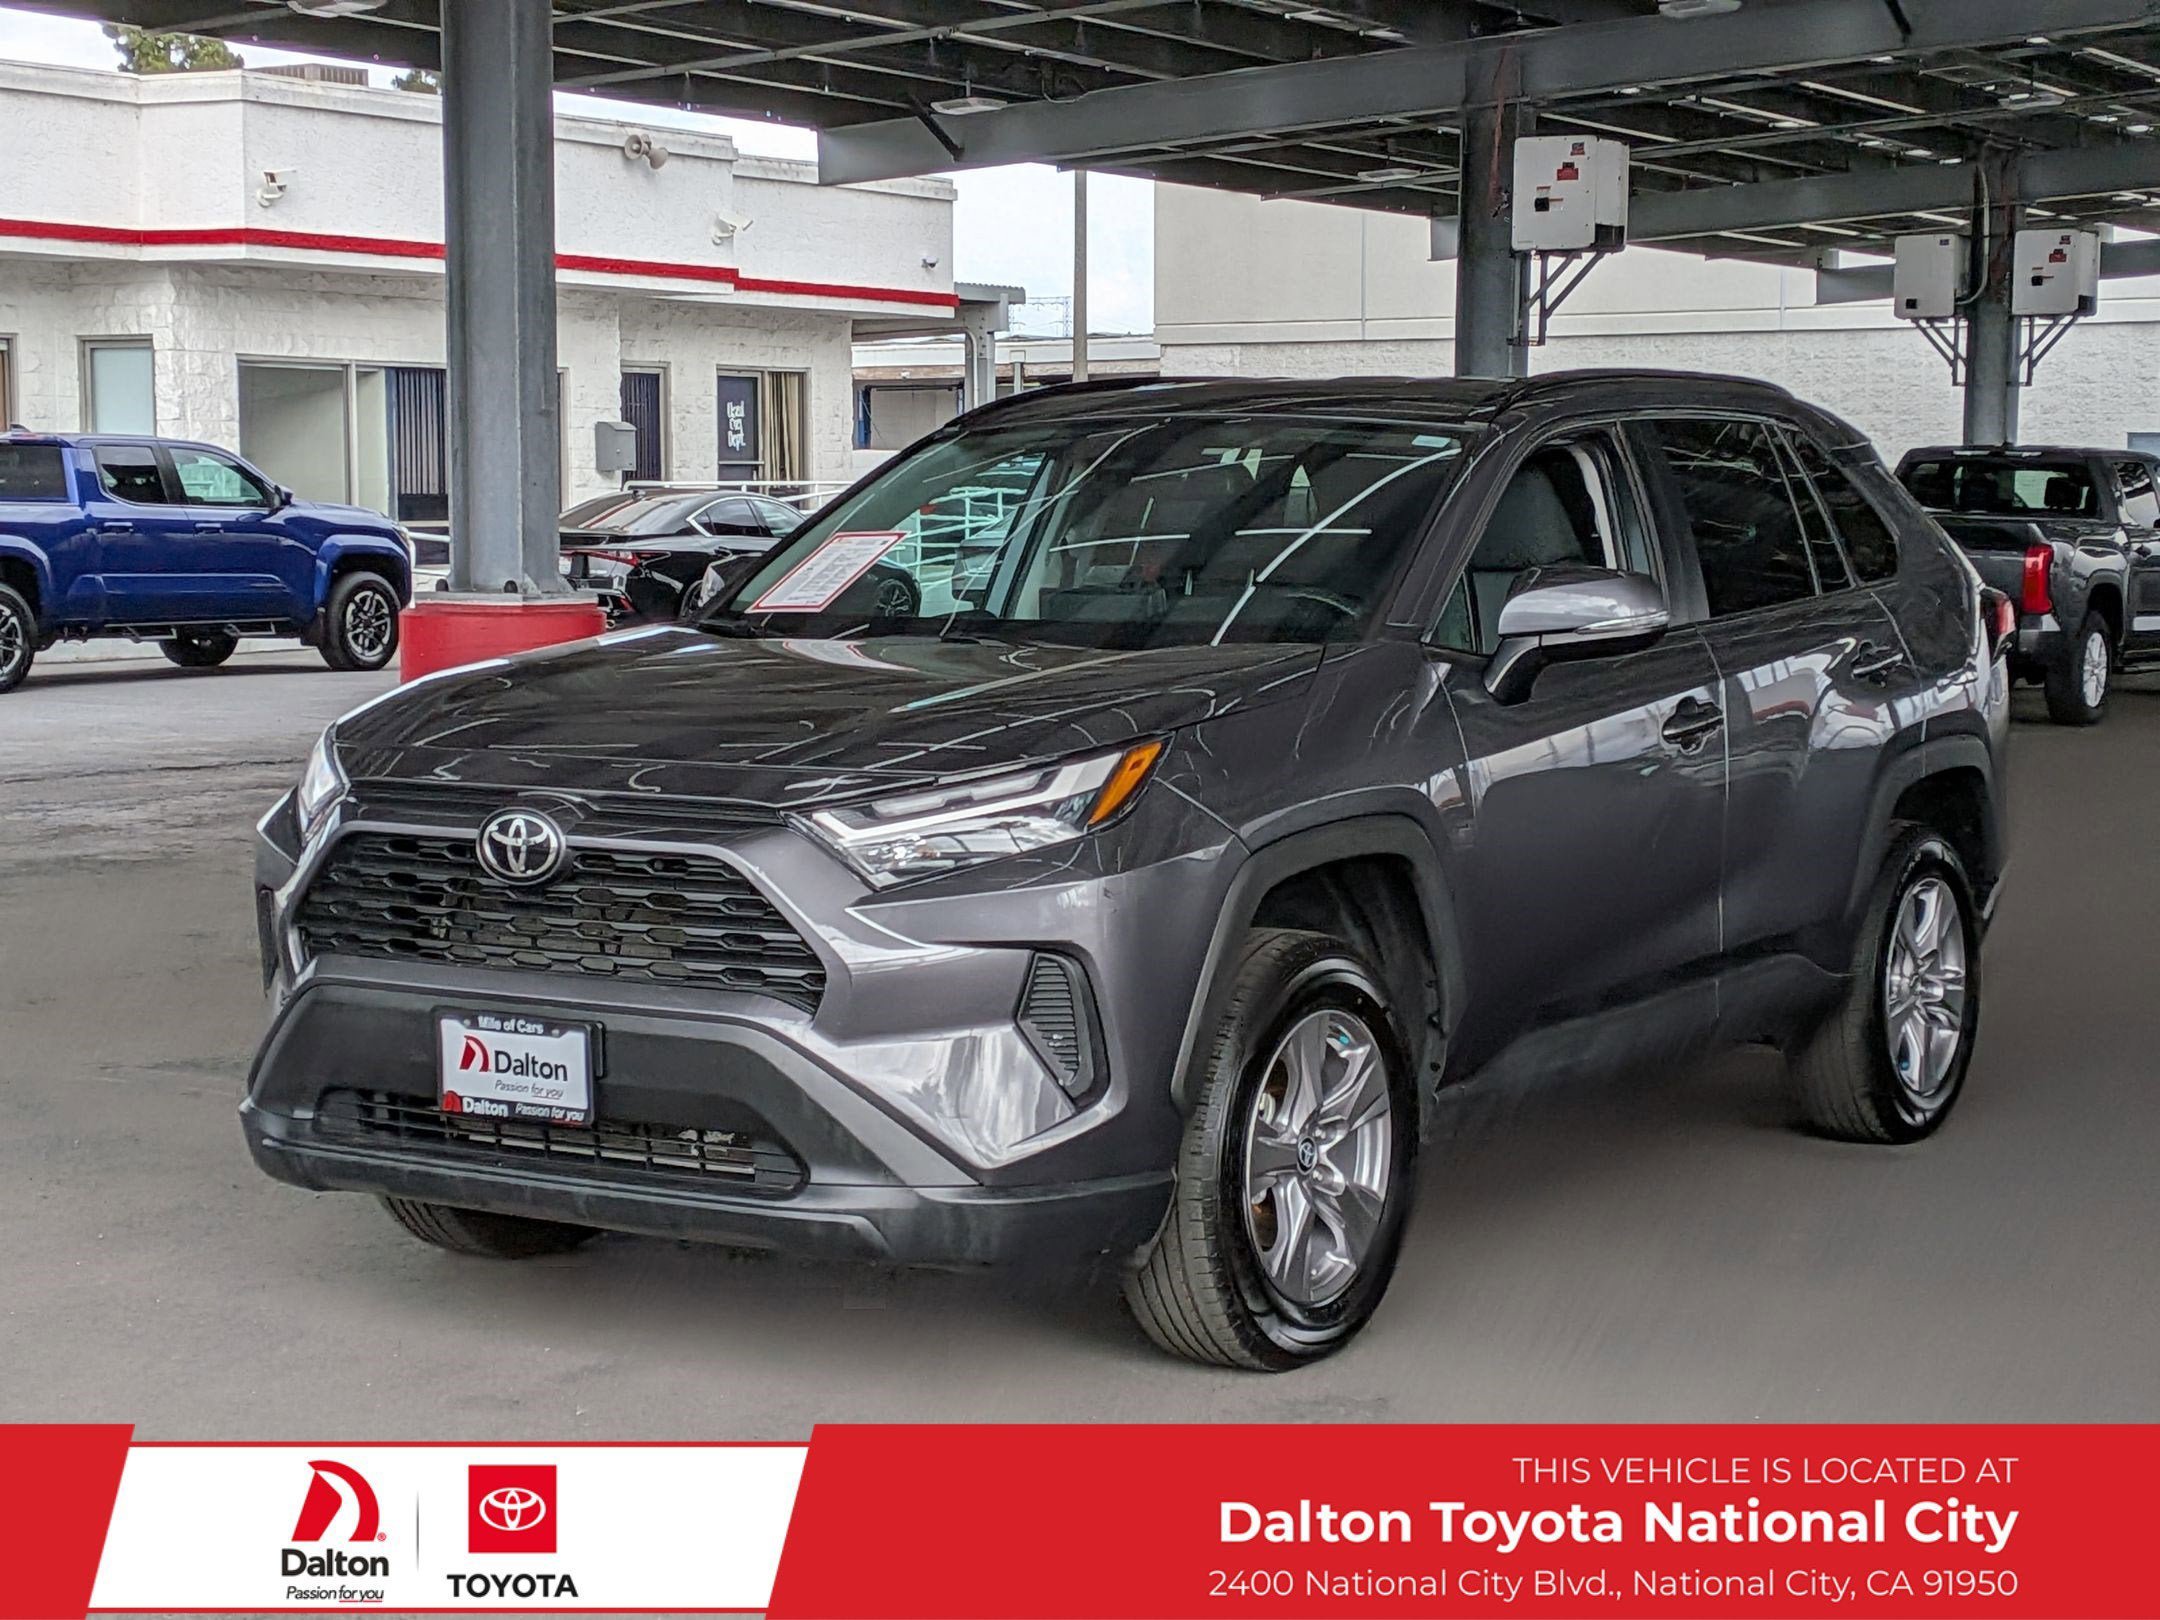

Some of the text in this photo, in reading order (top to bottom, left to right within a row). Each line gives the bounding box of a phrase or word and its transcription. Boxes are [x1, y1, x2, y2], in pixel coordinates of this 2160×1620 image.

[478, 1016, 544, 1034] Mile of Cars
[494, 1050, 568, 1081] Dalton
[494, 1079, 564, 1099] Passion for you
[462, 1097, 585, 1122] Dalton Passion for you
